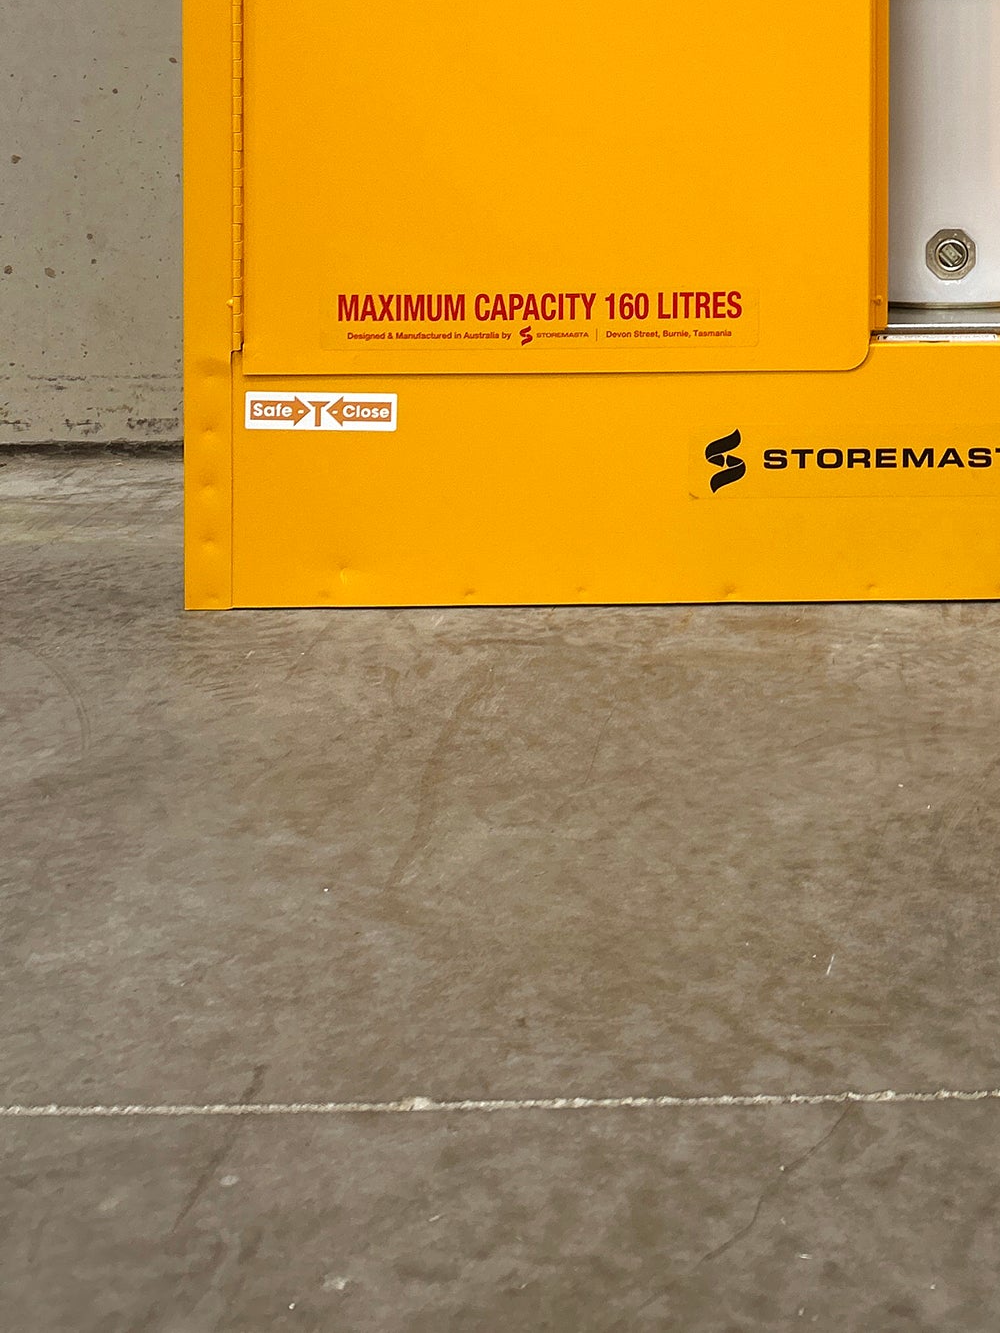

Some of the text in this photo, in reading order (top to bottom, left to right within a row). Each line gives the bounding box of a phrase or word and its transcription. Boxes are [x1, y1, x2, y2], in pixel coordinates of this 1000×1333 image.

[337, 291, 743, 322] MAXIMUM CAPACITY 160 LITRES
[347, 331, 512, 341] Designed & Manufactured in Australia by
[606, 329, 732, 339] Devon Street, Burnie, Tasmania
[252, 402, 293, 417] Safe
[342, 404, 390, 419] Close
